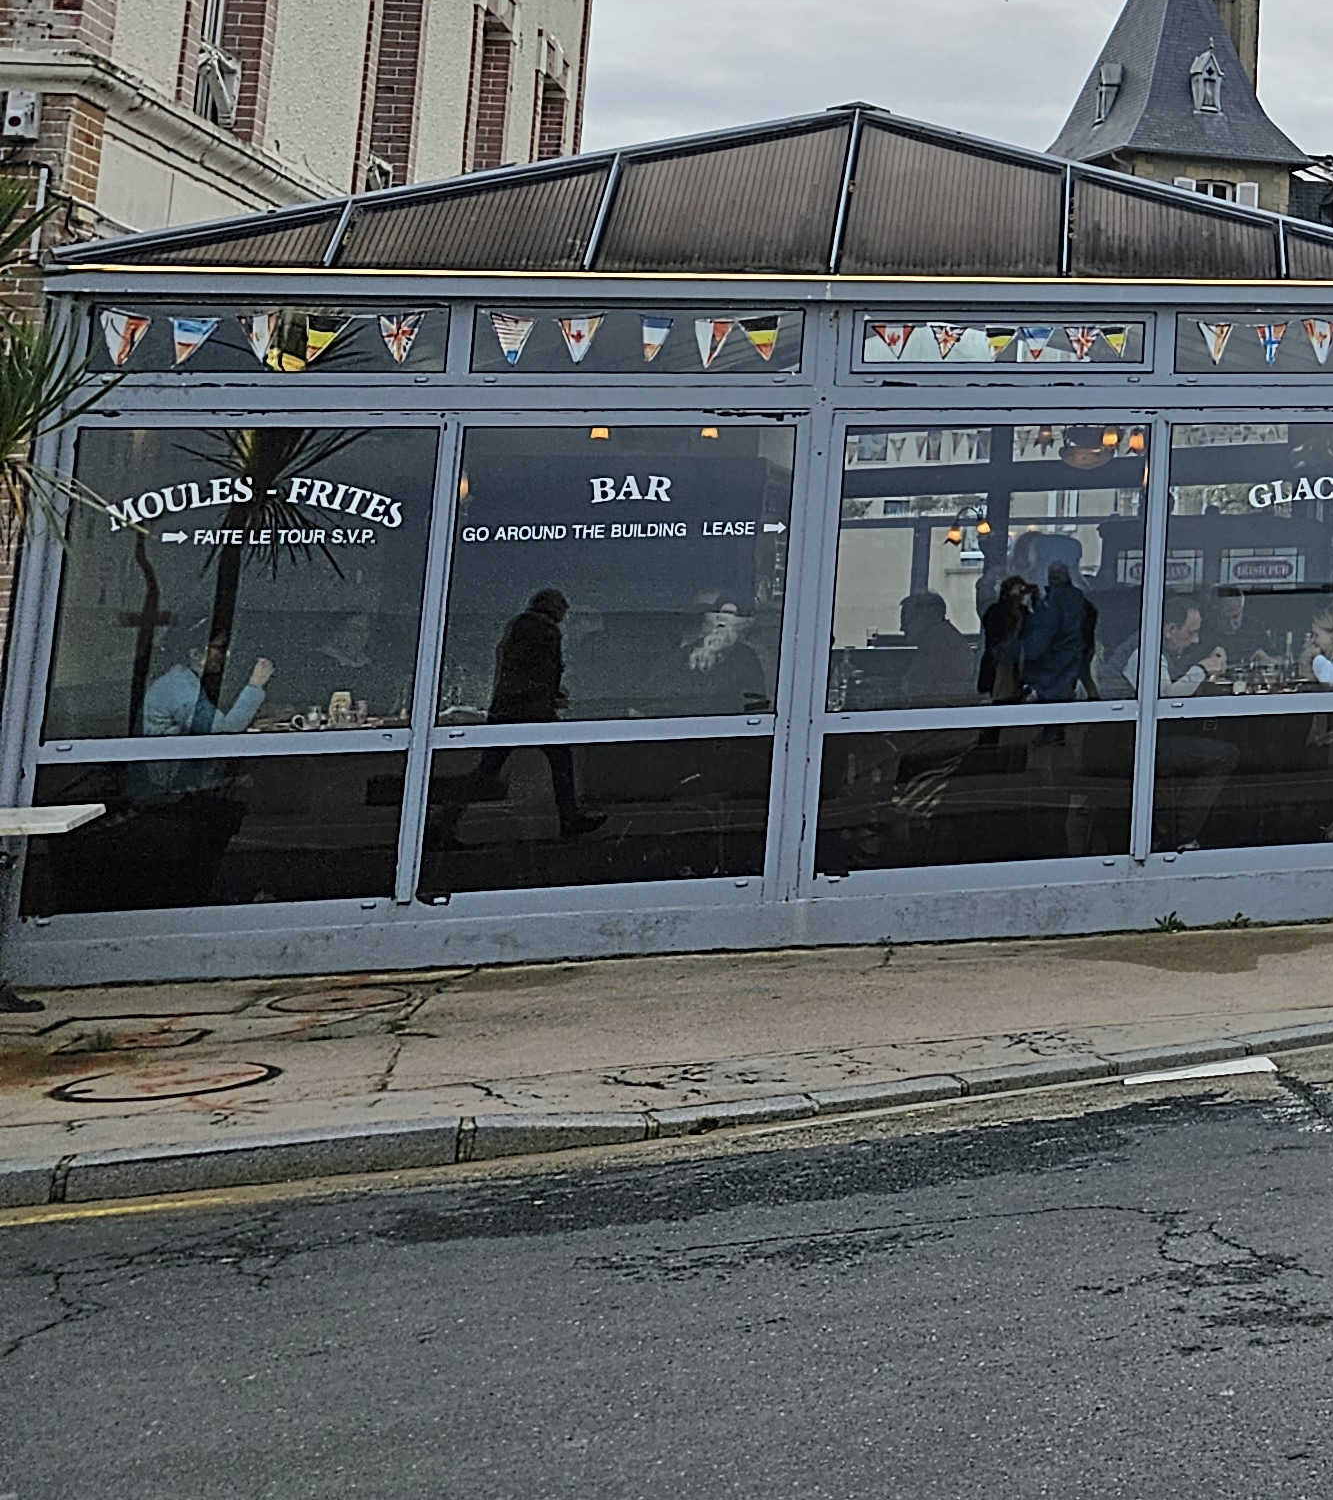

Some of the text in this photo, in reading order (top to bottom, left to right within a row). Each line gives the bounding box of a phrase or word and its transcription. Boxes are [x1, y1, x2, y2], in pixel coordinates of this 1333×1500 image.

[590, 475, 672, 504] BAR
[106, 476, 253, 532] MOULES
[286, 476, 403, 529] FRITES
[193, 528, 376, 545] FAITE LE TOUR S.V.P.
[462, 521, 756, 542] GO AROUND THE BUILDING LEASE
